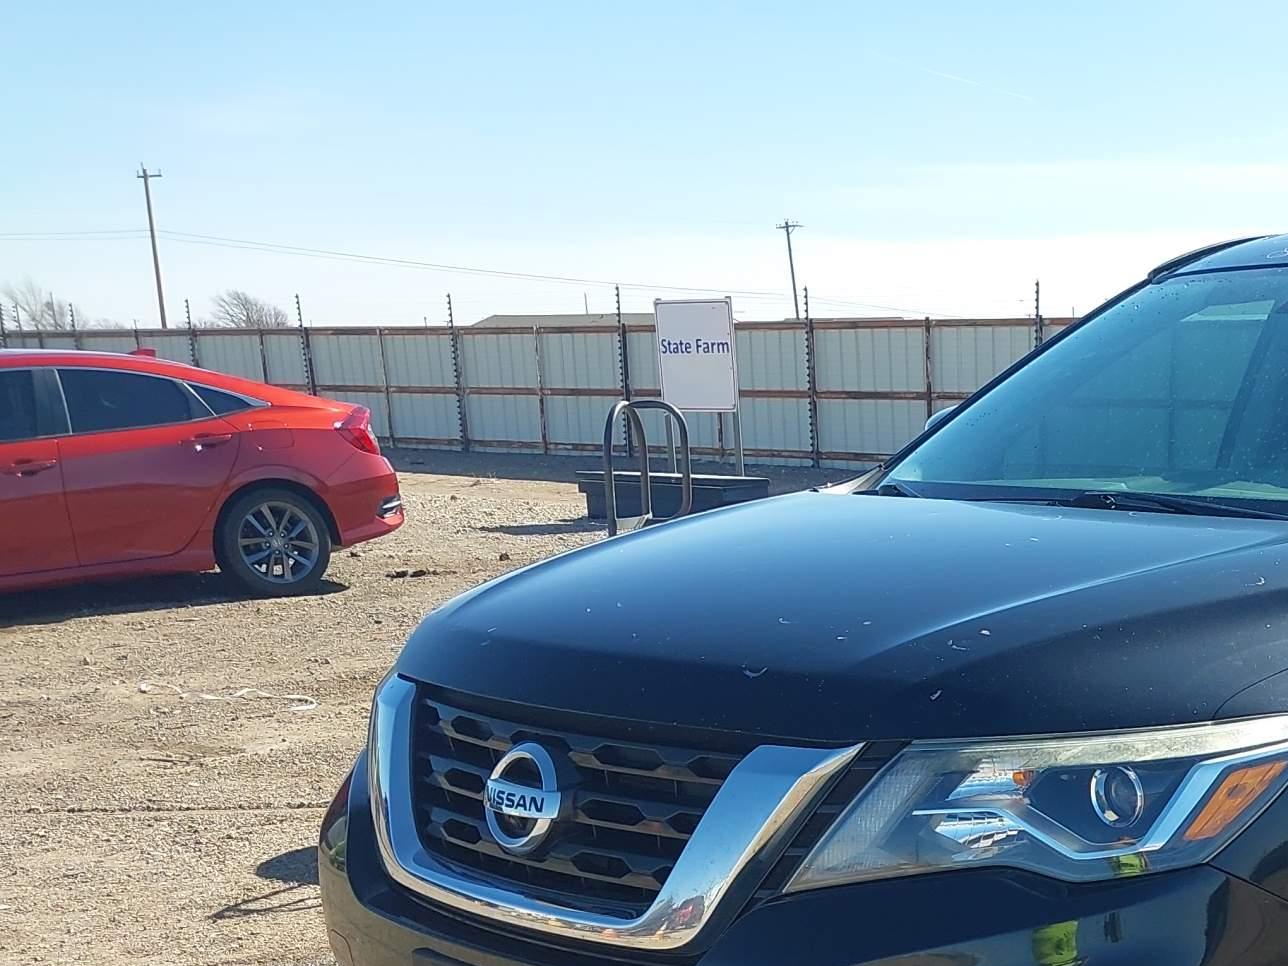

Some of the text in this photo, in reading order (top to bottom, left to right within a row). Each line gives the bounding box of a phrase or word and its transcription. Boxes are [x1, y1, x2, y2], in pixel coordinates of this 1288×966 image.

[661, 339, 730, 354] State Farm
[486, 785, 545, 814] NISSAN
